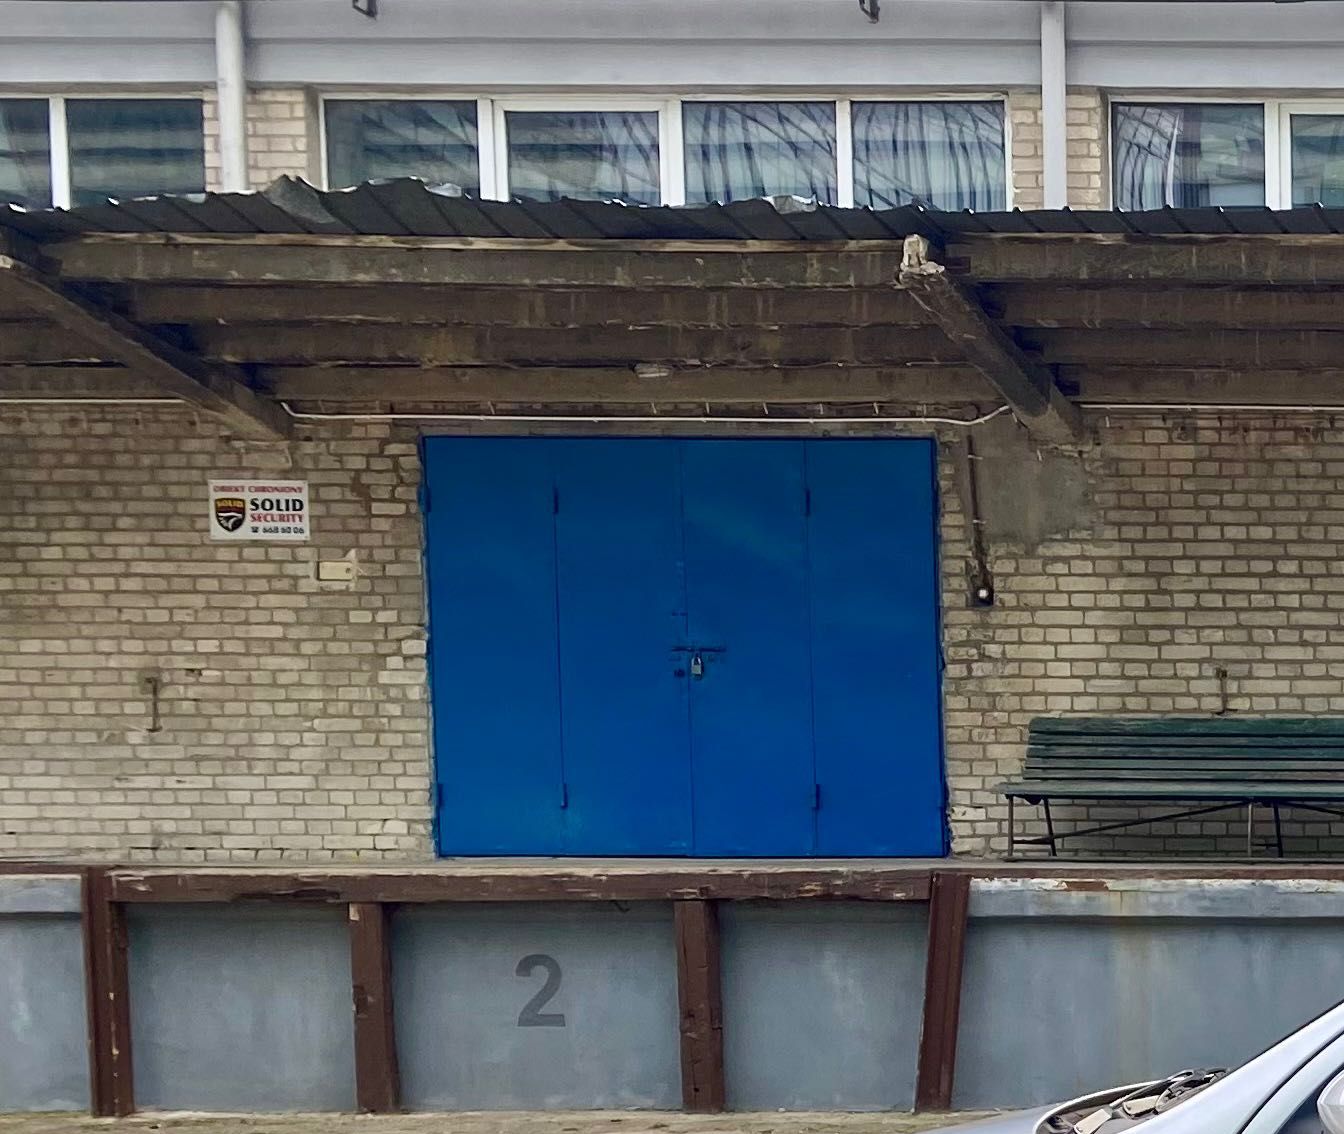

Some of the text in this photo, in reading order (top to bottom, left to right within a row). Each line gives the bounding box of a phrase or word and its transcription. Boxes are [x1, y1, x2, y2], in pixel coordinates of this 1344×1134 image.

[250, 498, 304, 512] SOLID
[250, 513, 304, 523] SECURITY
[515, 953, 566, 1028] 2
